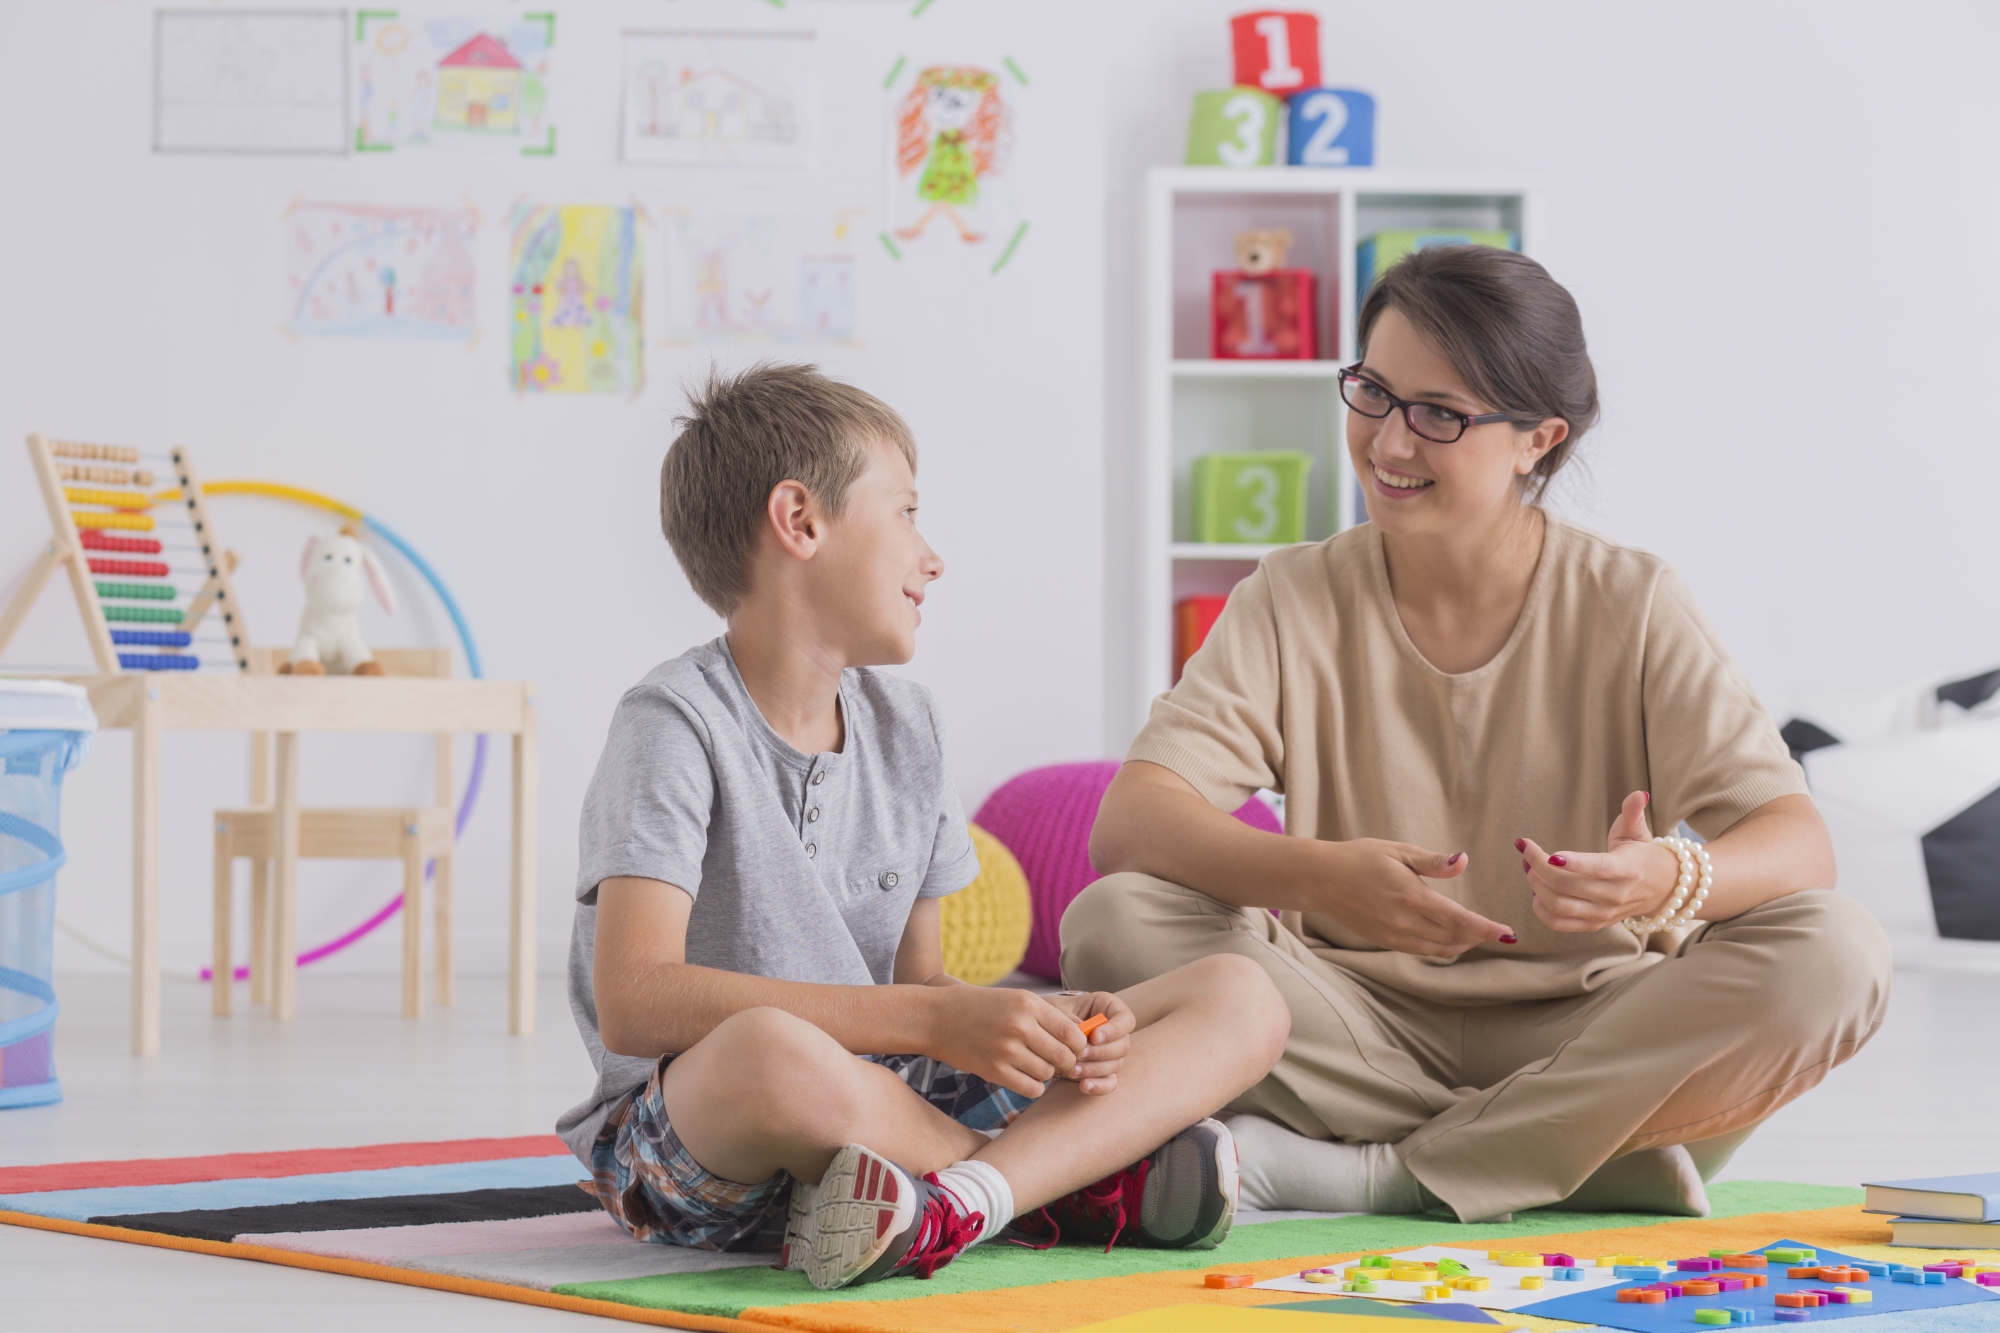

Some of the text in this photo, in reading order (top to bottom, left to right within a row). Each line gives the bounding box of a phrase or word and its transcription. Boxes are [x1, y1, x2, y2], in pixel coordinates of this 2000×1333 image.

[1256, 17, 1303, 87] 1
[1217, 95, 1266, 166] 3
[1302, 94, 1350, 166] 2
[1234, 282, 1277, 356] 1
[1233, 466, 1280, 541] 3
